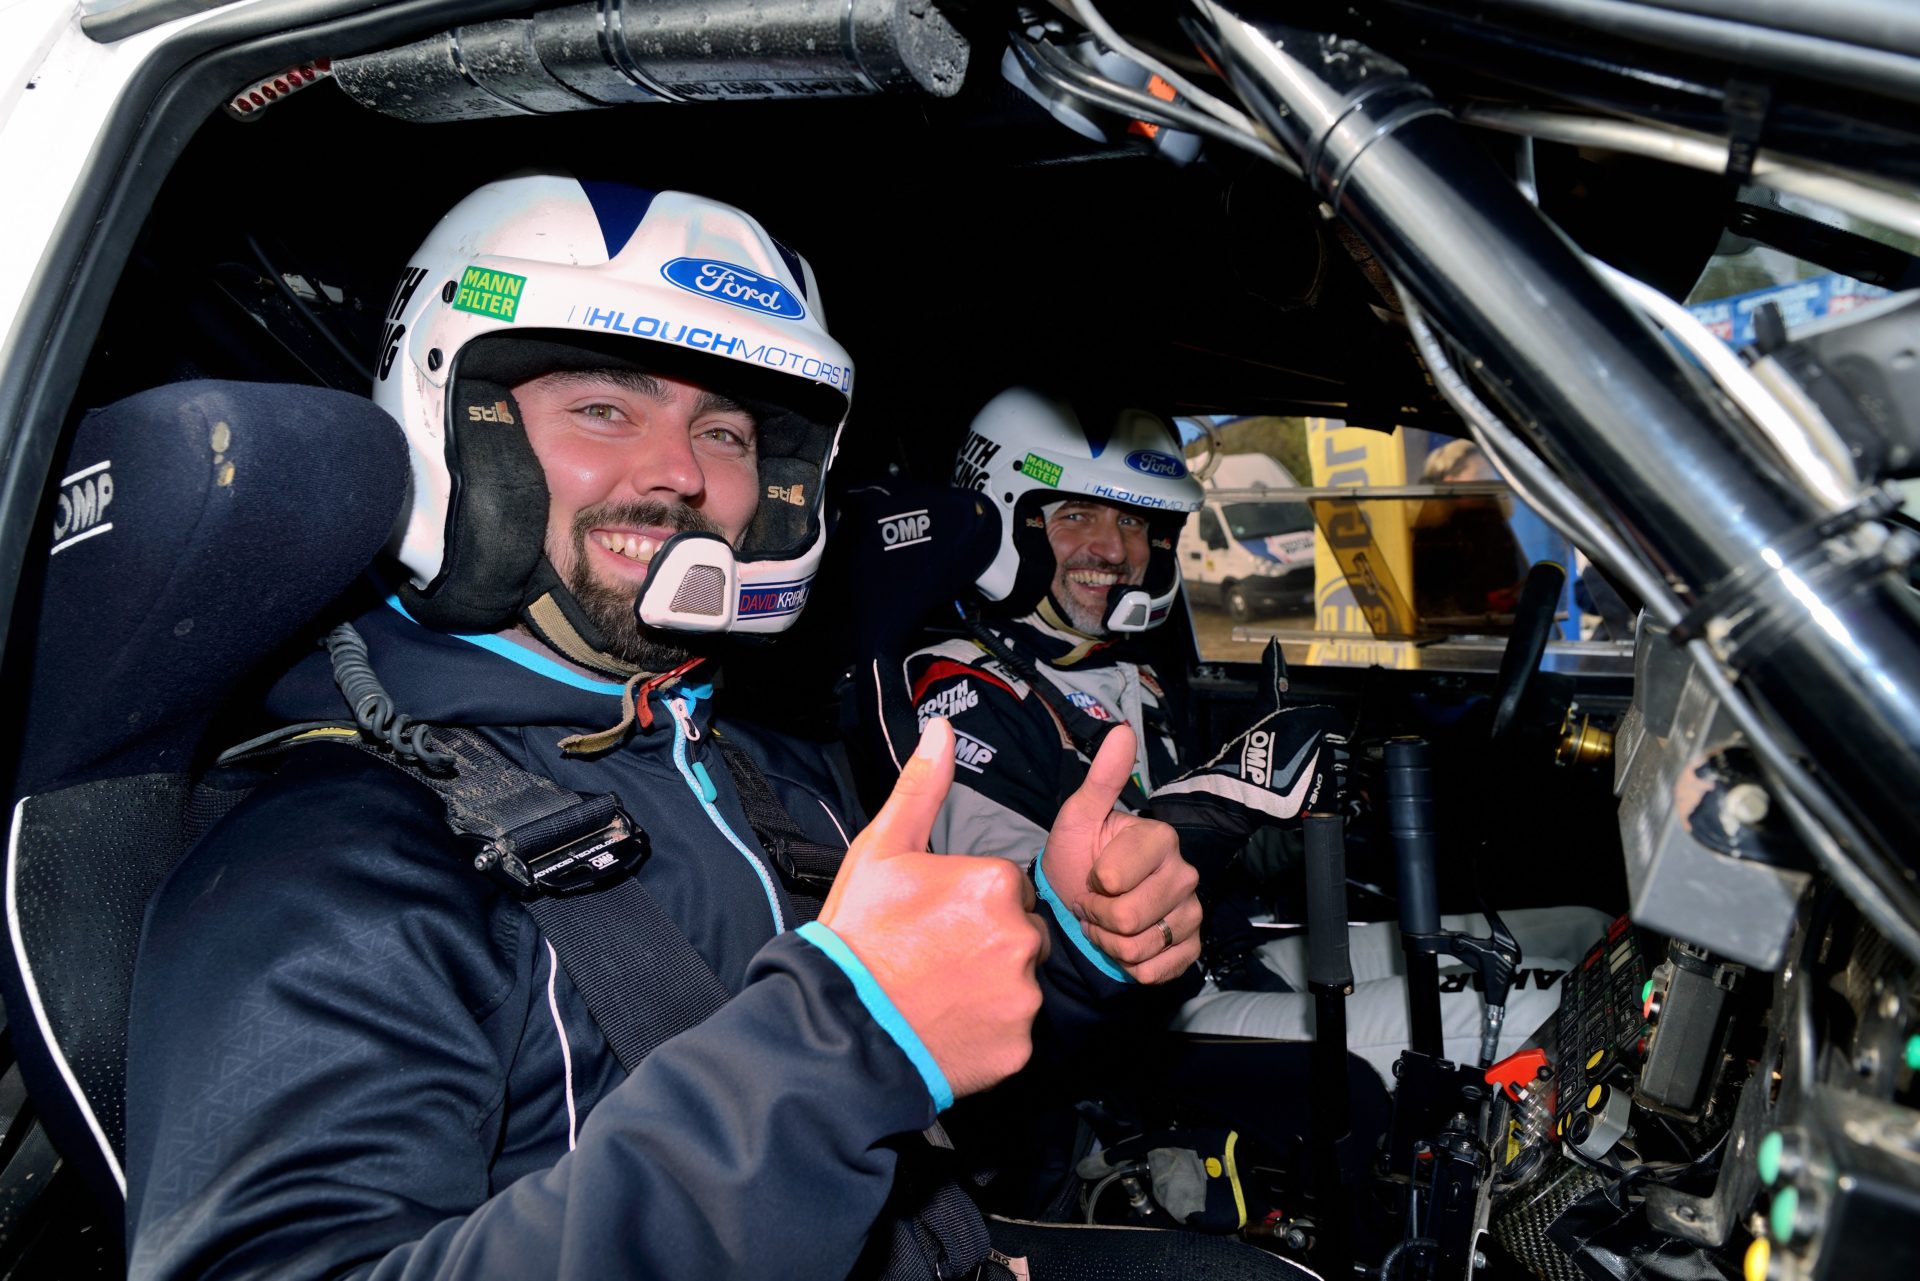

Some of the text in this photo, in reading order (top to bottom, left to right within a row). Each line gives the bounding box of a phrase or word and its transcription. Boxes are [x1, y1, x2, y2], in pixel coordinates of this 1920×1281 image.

[464, 269, 522, 297] MANN
[695, 264, 782, 312] Ford
[457, 288, 515, 317] FILTER
[1023, 463, 1058, 487] FILTER
[1026, 454, 1062, 477] MANN
[1139, 453, 1178, 476] Ford
[53, 473, 114, 540] OMP
[882, 515, 931, 545] OMP
[917, 679, 969, 723] SOUTH
[918, 690, 978, 734] RCING
[955, 738, 993, 766] MP
[1245, 731, 1270, 785] OMP
[533, 857, 575, 879] ADVANCED
[591, 853, 614, 868] OMP
